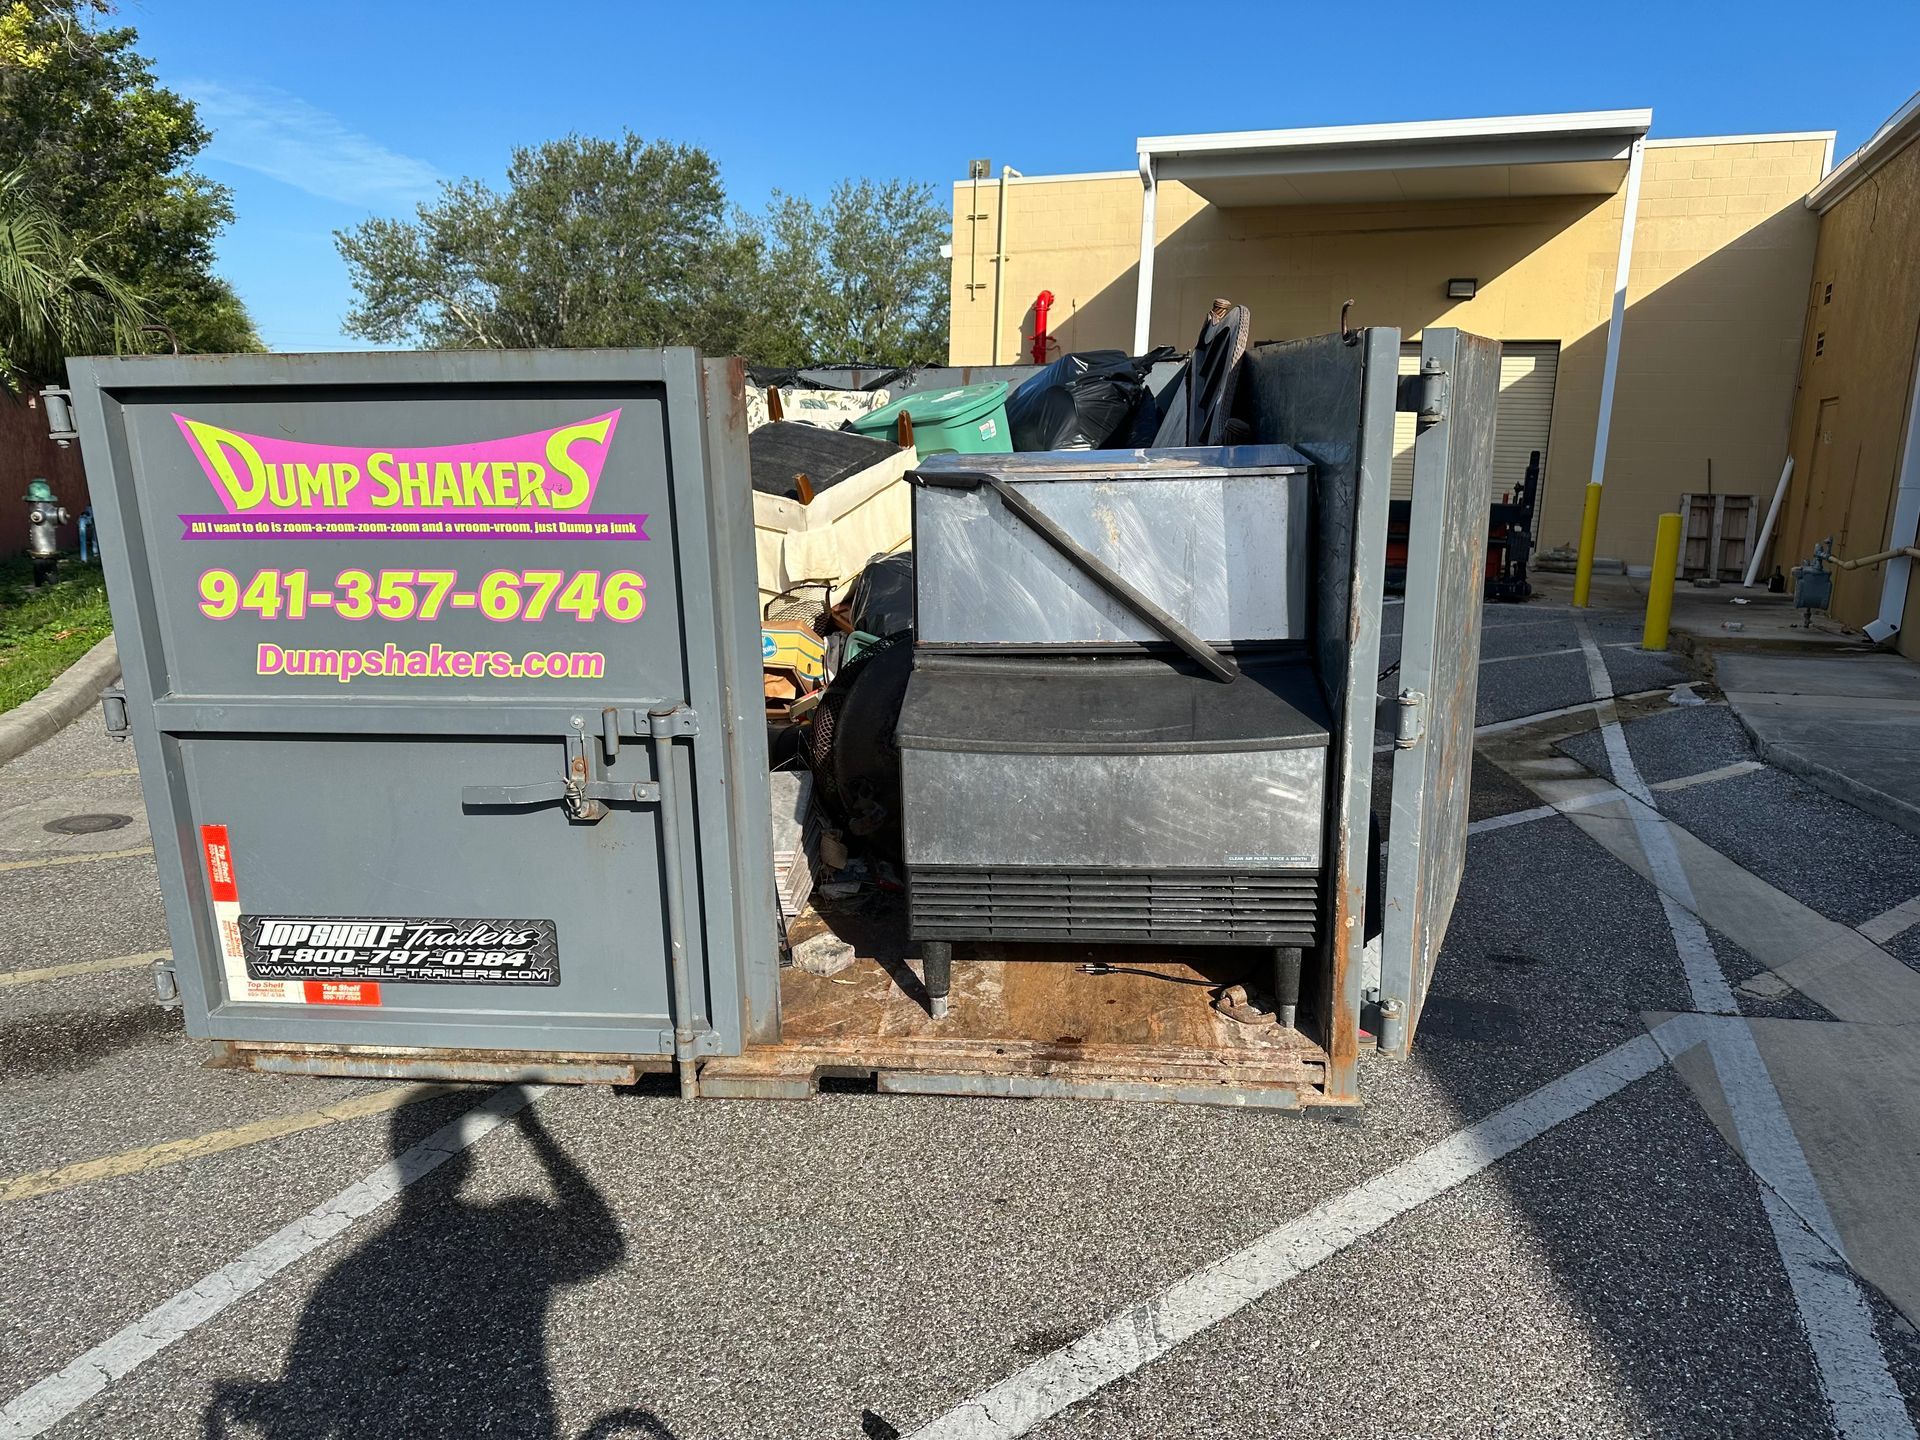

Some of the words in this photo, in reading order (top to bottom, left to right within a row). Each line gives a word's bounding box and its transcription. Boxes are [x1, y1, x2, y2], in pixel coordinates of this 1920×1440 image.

[184, 419, 361, 511] DUMP
[366, 416, 613, 510] SHAKERS
[191, 522, 206, 533] All
[207, 522, 211, 533] I
[213, 522, 241, 533] want
[242, 522, 253, 533] to
[255, 522, 269, 533] do
[271, 522, 281, 533] is
[283, 522, 420, 533] zoom-a-zoom-zoom-zoom
[422, 522, 442, 533] and
[445, 522, 452, 533] a
[454, 522, 533, 533] vroom-vroom,
[534, 522, 557, 534] just
[559, 522, 593, 534] Dump
[594, 522, 609, 534] ya
[610, 522, 637, 534] junk
[199, 568, 646, 622] 941-357-6746
[256, 643, 605, 683] Dumpshakers.com
[402, 922, 535, 950] Trailers
[268, 948, 527, 967] 1-800-797-0384
[247, 981, 261, 989] Top
[263, 981, 285, 989] Shelf
[321, 983, 337, 992] Top
[338, 984, 361, 992] Shelf
